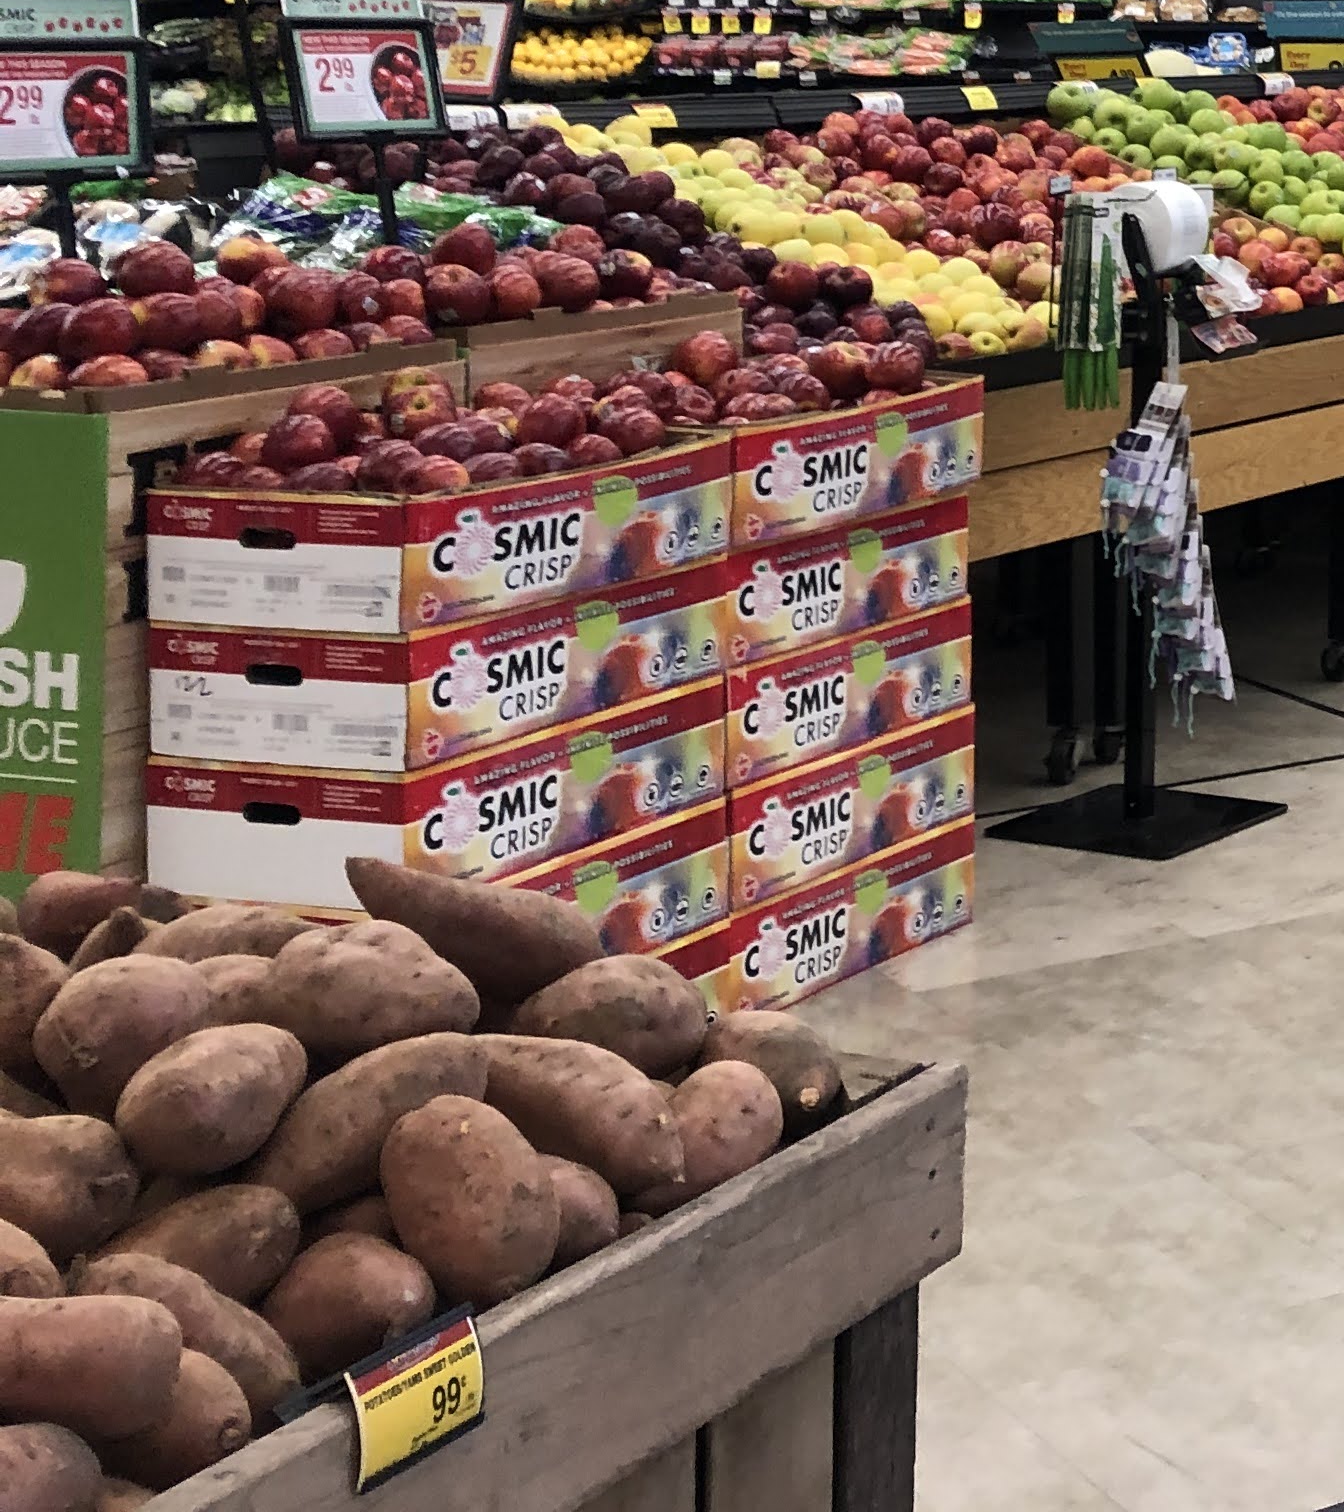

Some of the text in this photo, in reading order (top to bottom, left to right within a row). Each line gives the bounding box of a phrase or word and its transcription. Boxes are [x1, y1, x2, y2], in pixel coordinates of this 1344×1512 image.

[812, 481, 862, 513] CRISP
[504, 554, 573, 590] CRISP
[791, 599, 839, 631] CRISP
[499, 683, 562, 722] CRISP
[793, 712, 841, 747] CRISP
[489, 816, 553, 860] CRISP
[801, 829, 848, 865] CRISP
[794, 945, 842, 984] CRISP
